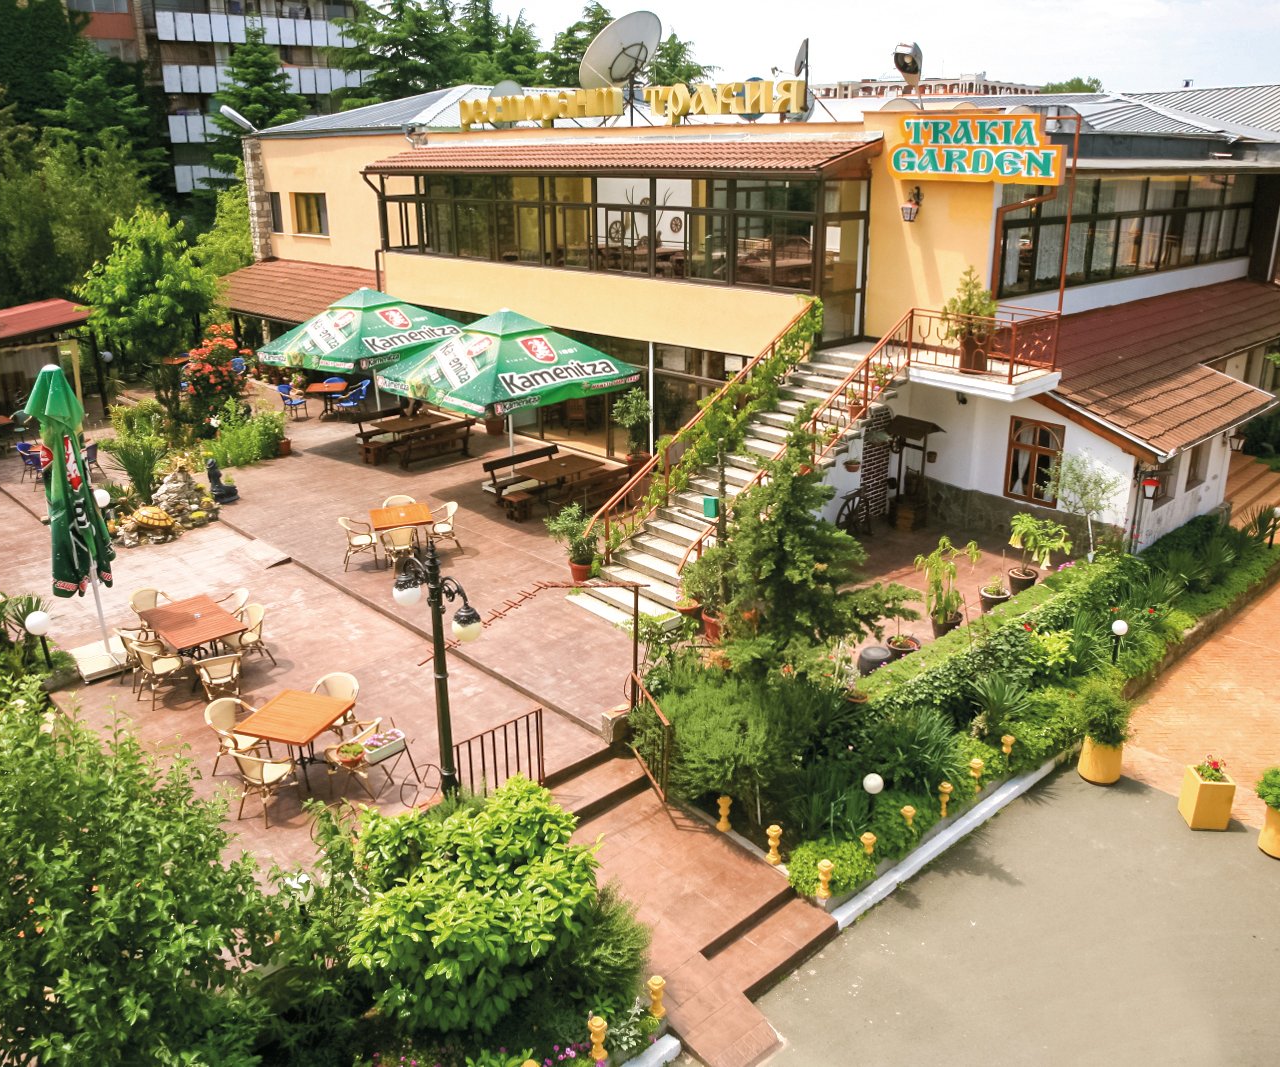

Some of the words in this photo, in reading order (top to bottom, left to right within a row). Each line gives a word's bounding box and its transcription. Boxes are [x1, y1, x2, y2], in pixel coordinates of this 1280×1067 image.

[642, 80, 807, 126] тракия
[904, 119, 1040, 146] TRAKIA
[892, 147, 1057, 178] GARDEN
[363, 325, 462, 353] Kamenitza
[500, 360, 617, 395] Kamenitza
